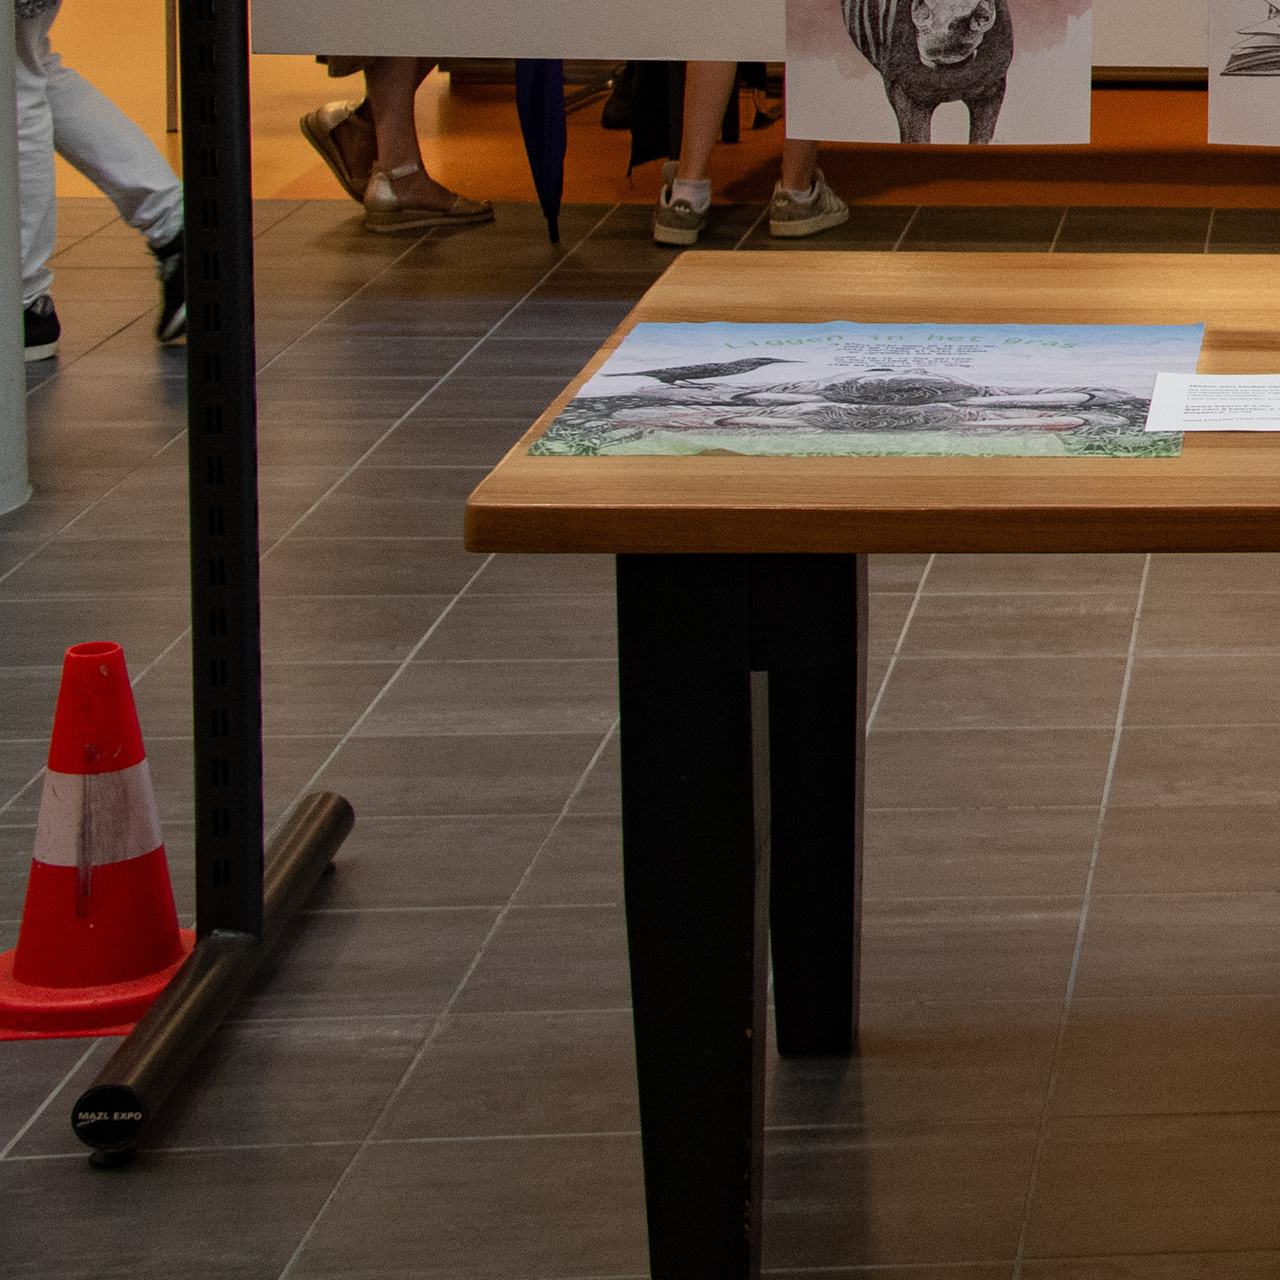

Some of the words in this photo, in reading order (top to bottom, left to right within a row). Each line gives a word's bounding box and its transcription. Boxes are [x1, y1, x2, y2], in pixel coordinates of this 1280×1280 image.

[726, 334, 843, 348] Liggen
[928, 334, 980, 342] het
[1003, 337, 1075, 348] gras
[78, 1111, 109, 1121] MAZL
[113, 1111, 142, 1121] EXPO
